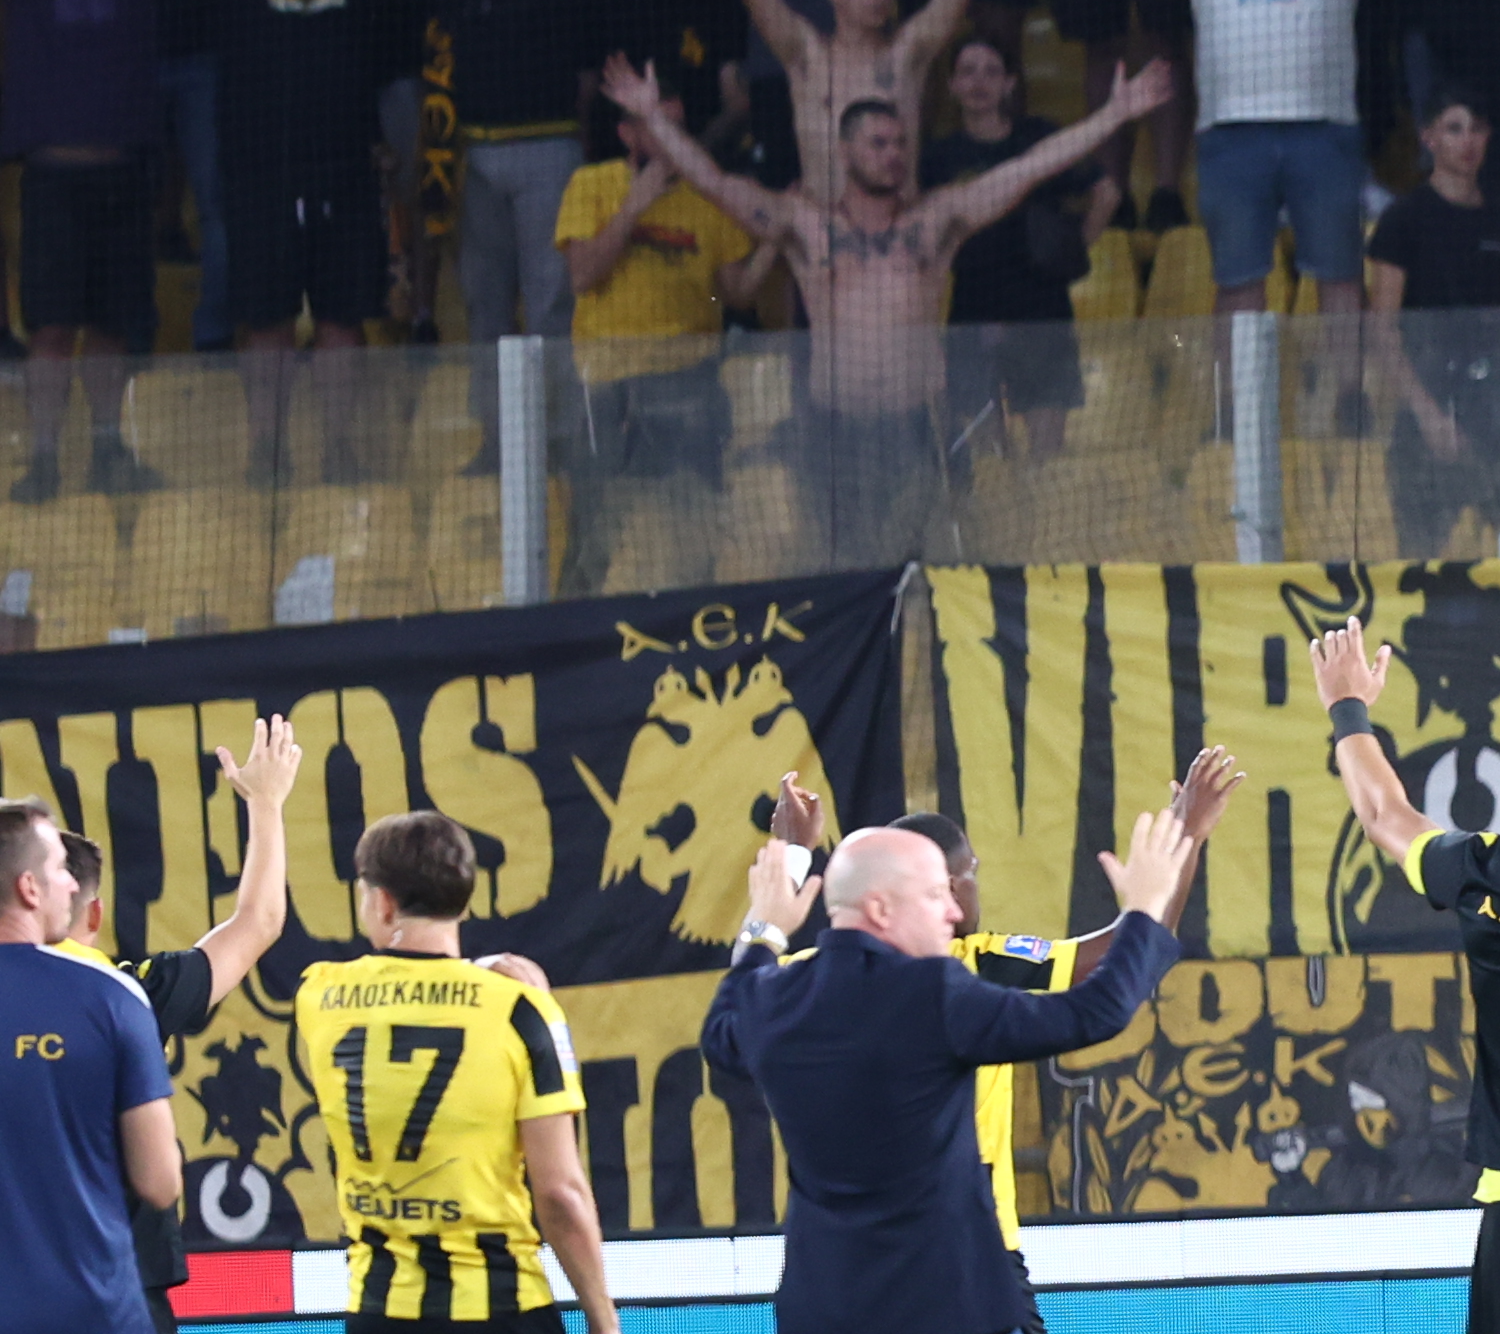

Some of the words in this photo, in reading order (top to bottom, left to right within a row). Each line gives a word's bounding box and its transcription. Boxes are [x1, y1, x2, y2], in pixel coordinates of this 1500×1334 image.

[320, 981, 483, 1011] ΚΑΛΟΣΚΑΜΗΣ
[15, 1033, 65, 1060] FC
[333, 1024, 466, 1162] 17
